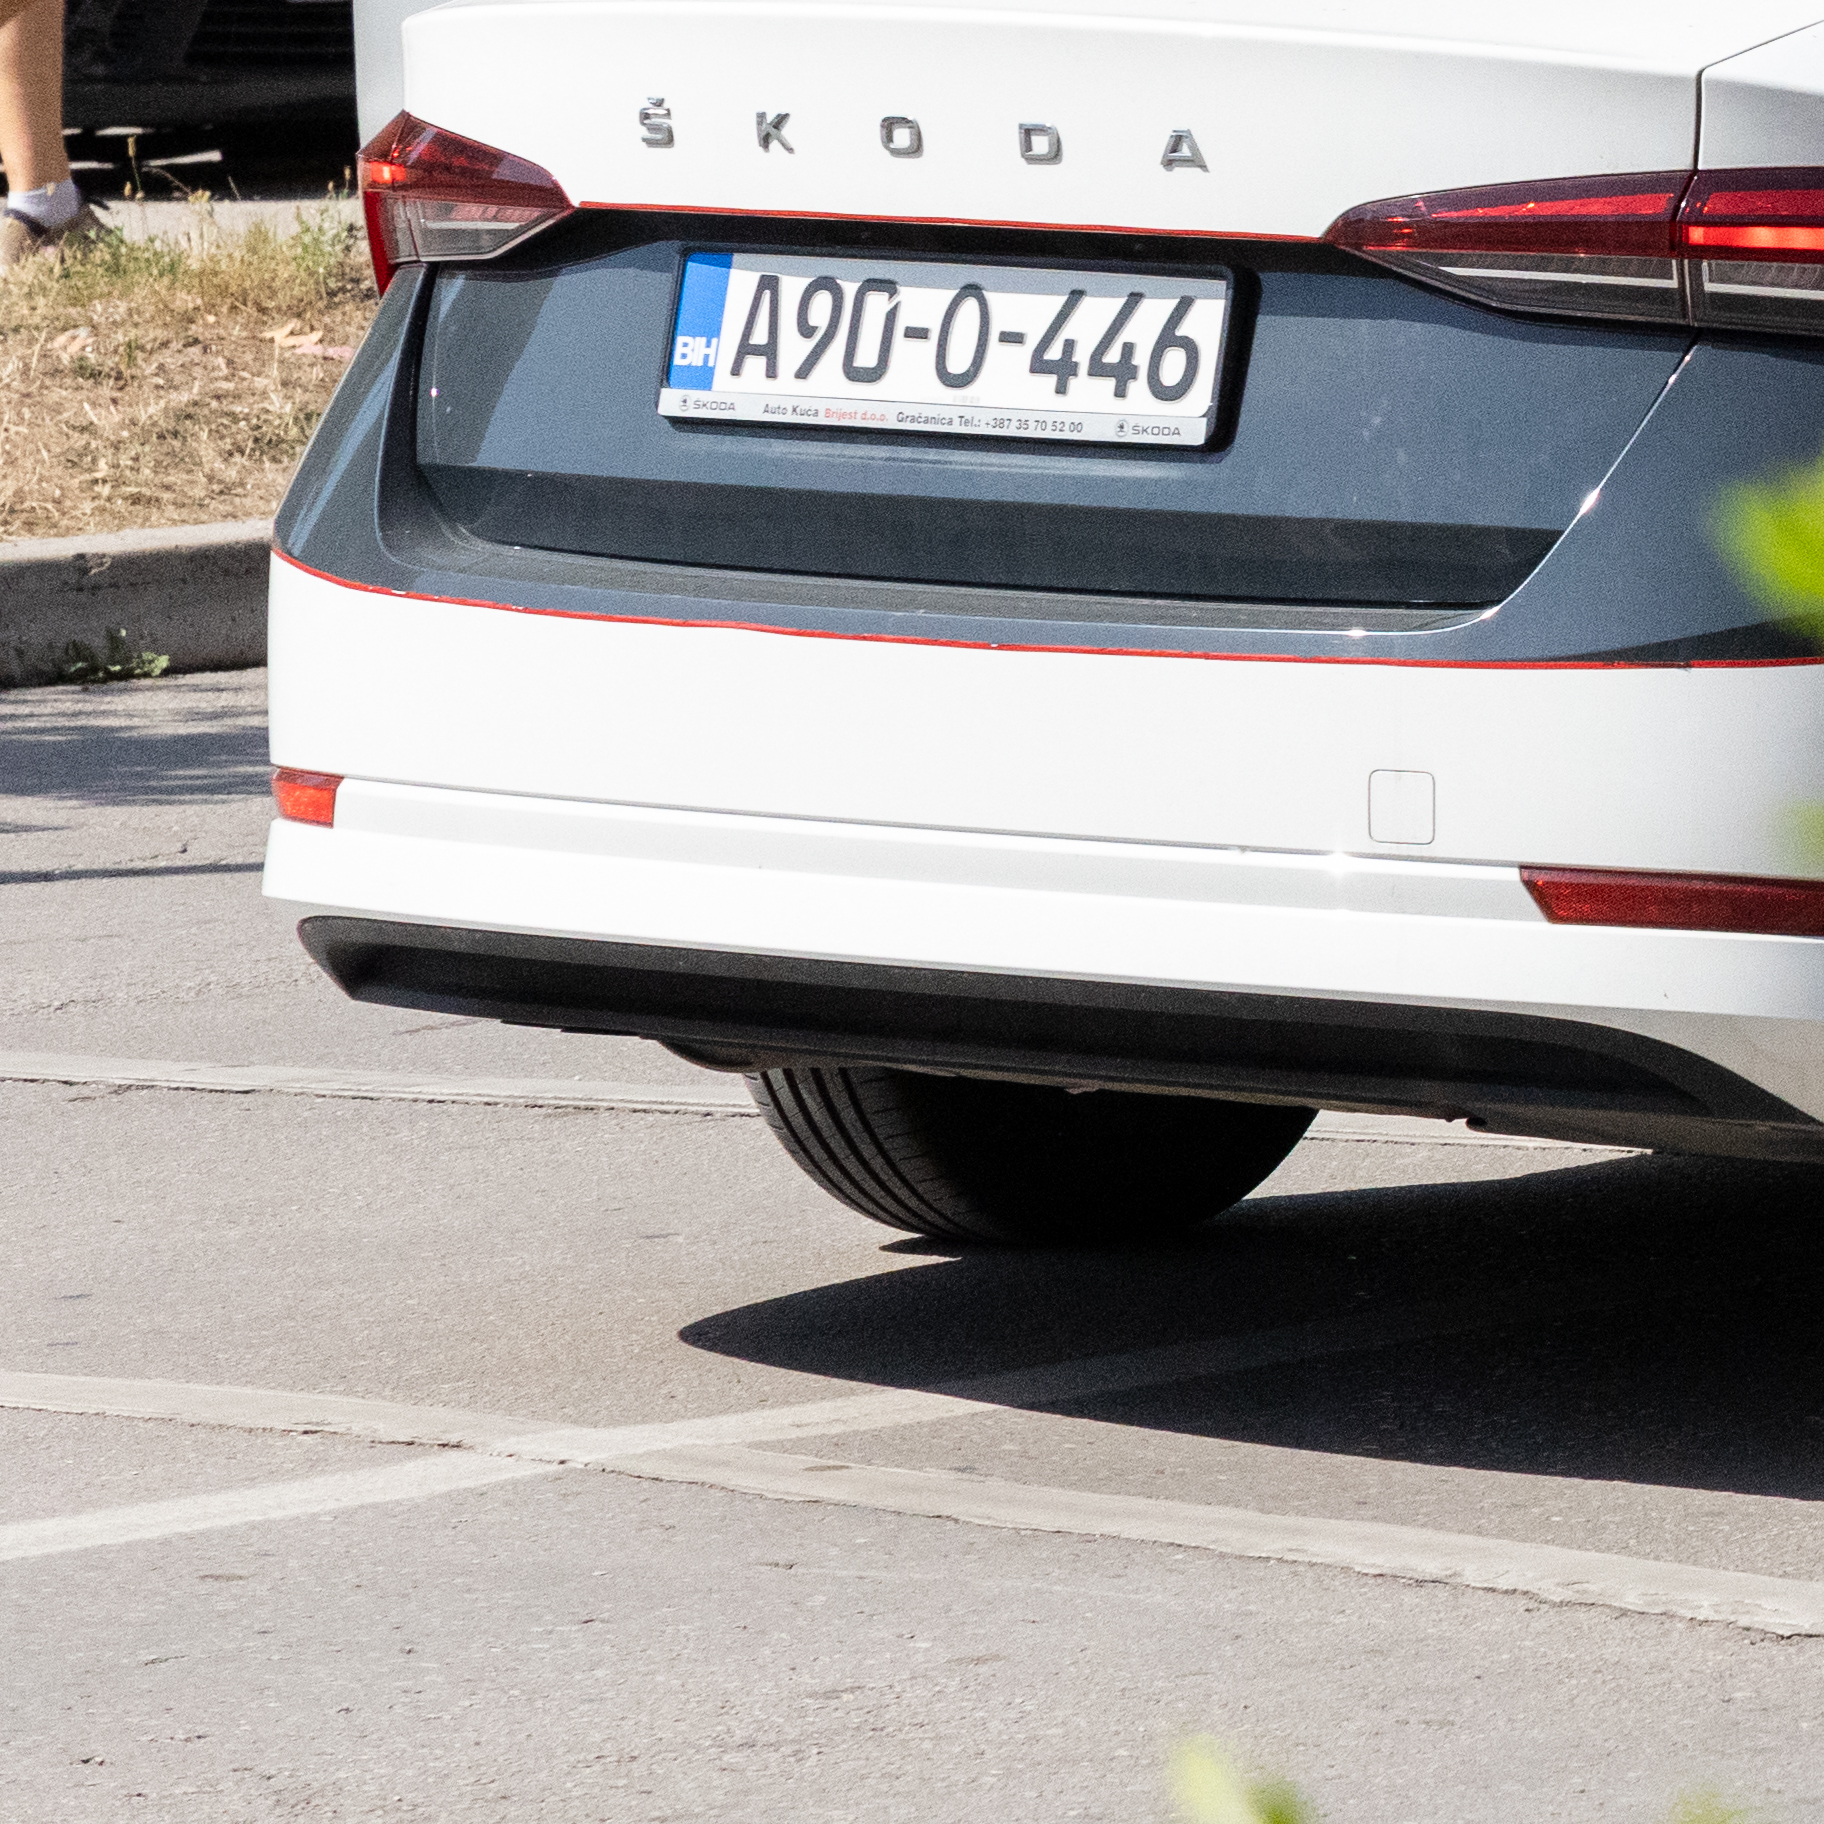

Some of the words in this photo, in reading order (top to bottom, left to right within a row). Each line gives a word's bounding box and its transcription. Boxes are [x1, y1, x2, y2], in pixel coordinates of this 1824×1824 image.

[639, 96, 1211, 174] ŠKODA
[673, 335, 719, 368] BIH
[692, 399, 736, 413] ŠKODA
[762, 403, 788, 416] Auto
[791, 404, 819, 419] Kuća
[824, 407, 859, 422] Brijest
[861, 409, 889, 423] d.o.o.
[896, 411, 954, 427] Gračanica
[958, 415, 982, 429] Tel.:
[985, 417, 1013, 431] +387
[1016, 418, 1031, 432] 35
[1034, 419, 1048, 433] 70
[1051, 420, 1066, 434] 52
[1069, 421, 1084, 435] 00
[1131, 423, 1182, 438] ŠKODA
